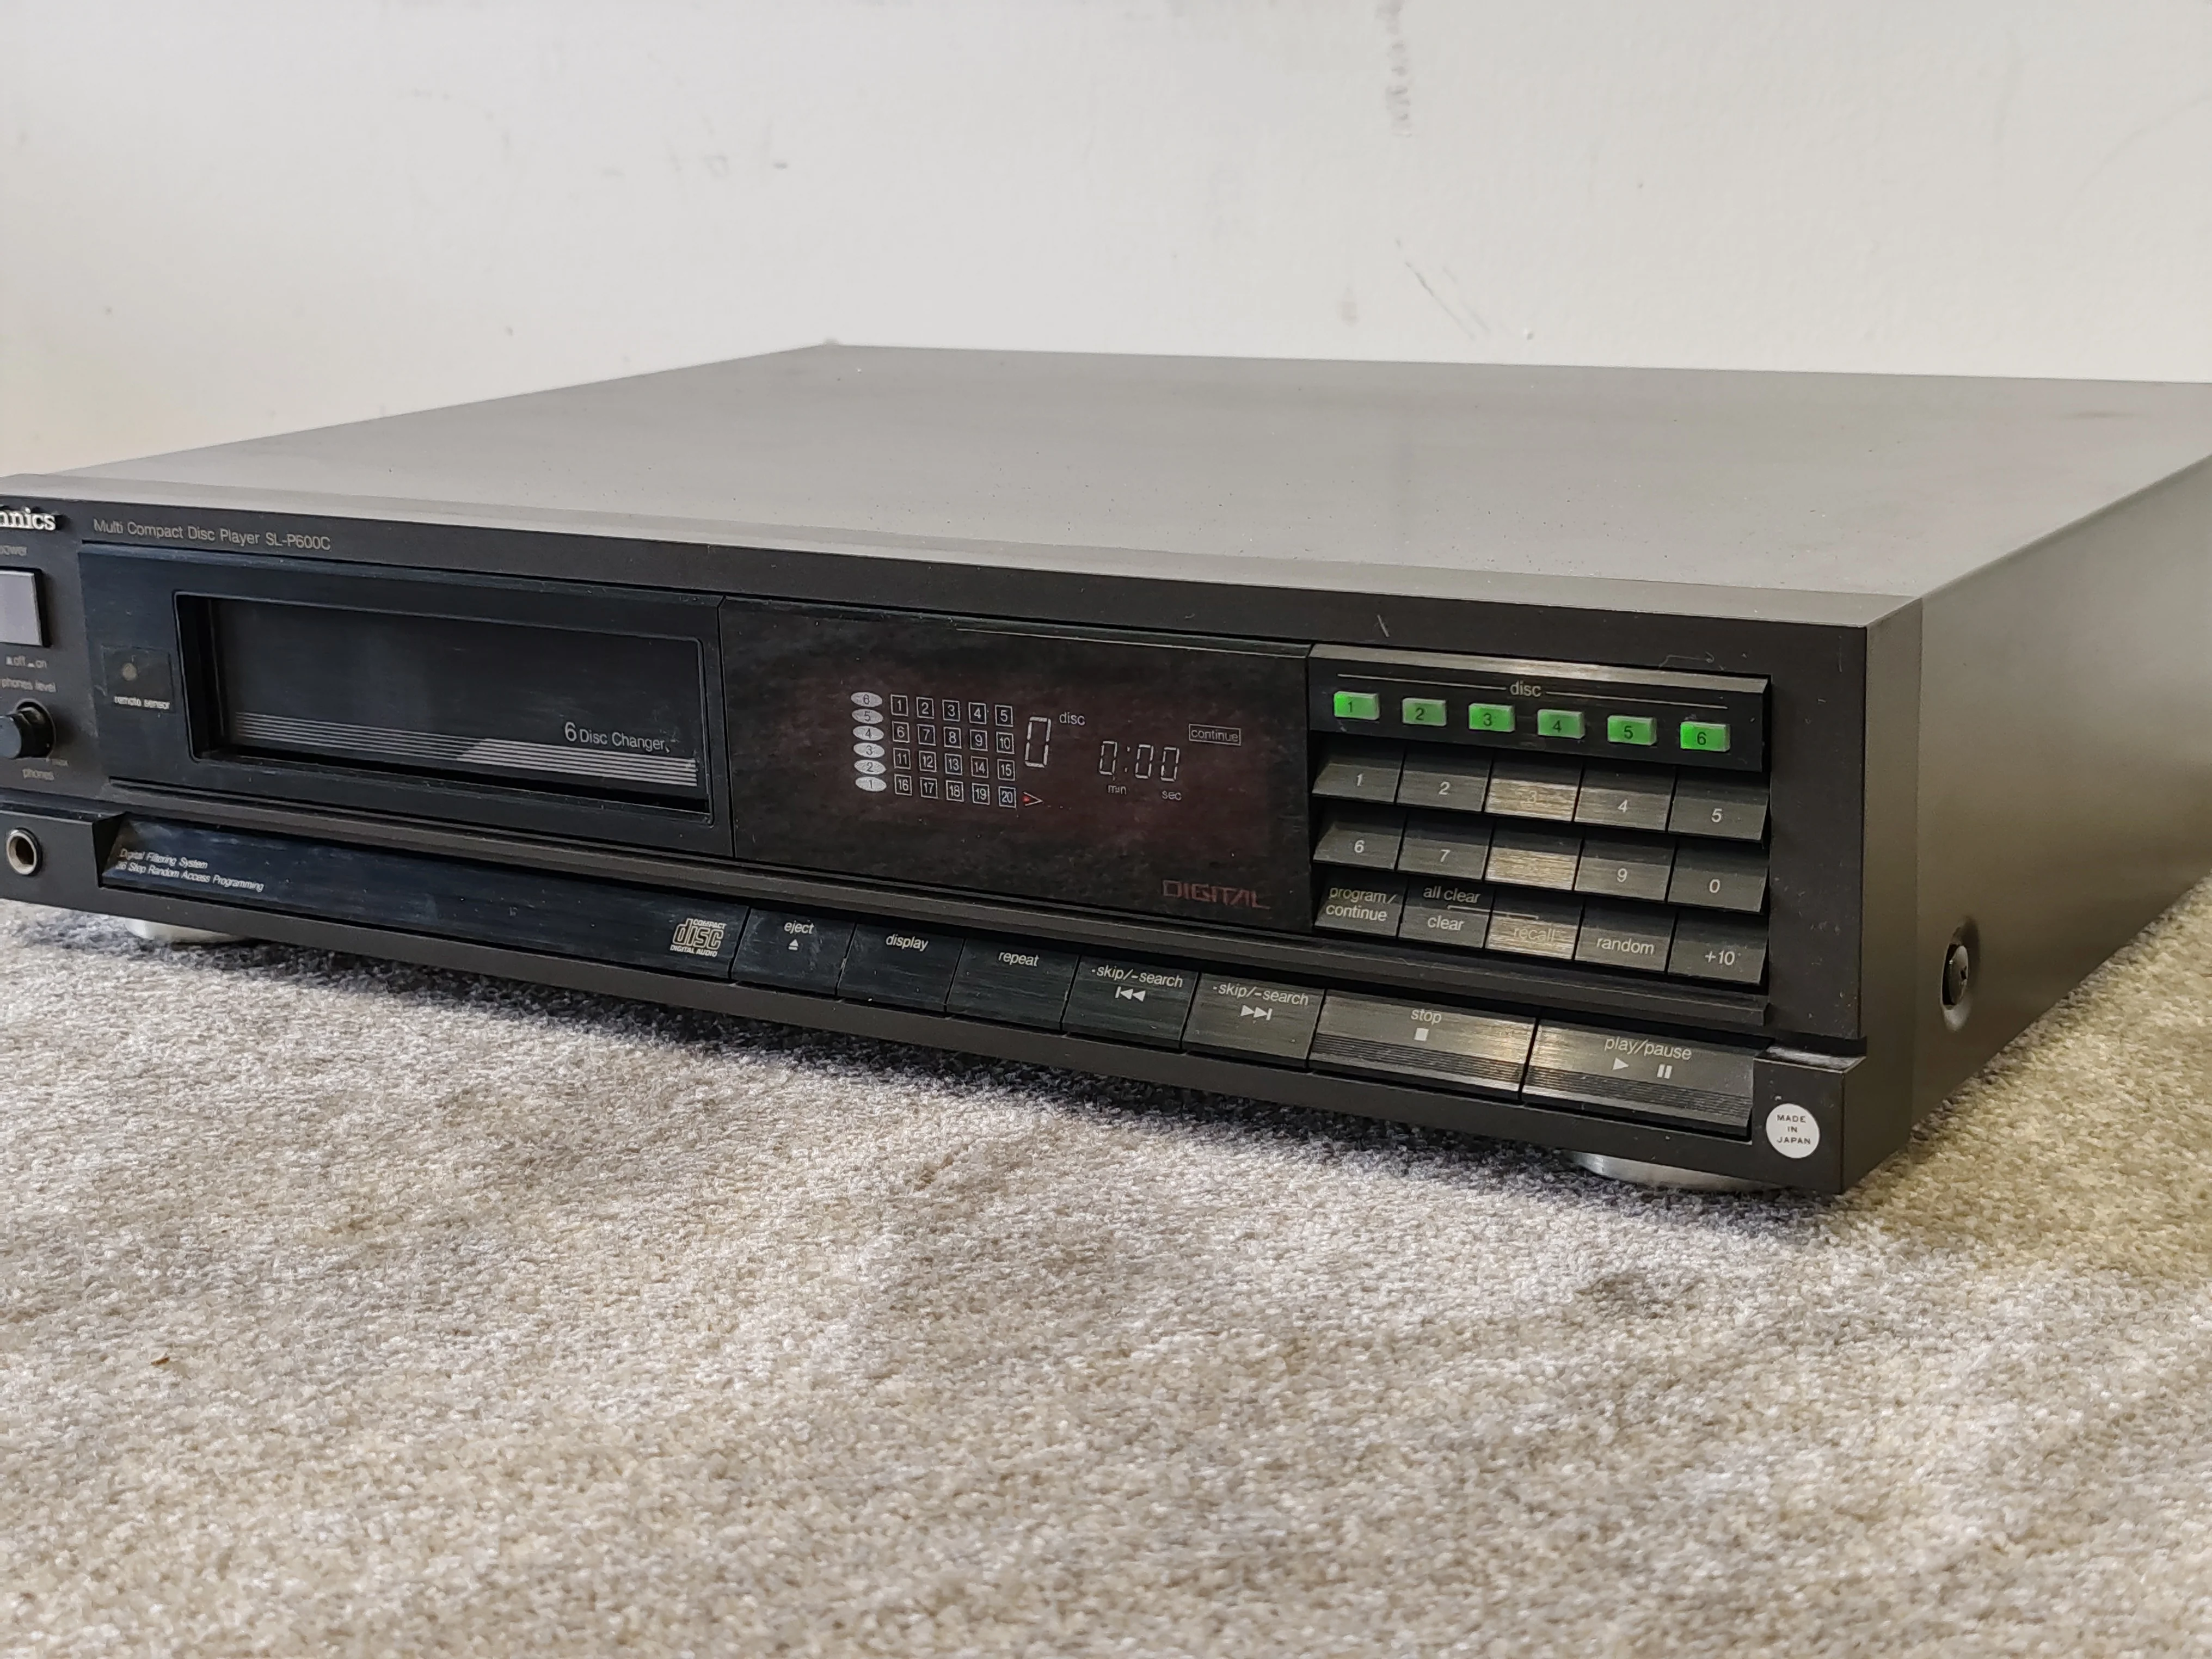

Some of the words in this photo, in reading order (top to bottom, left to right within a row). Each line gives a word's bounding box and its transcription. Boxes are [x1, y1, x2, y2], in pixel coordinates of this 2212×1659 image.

[94, 518, 124, 534] Multi
[127, 521, 183, 539] Compact
[188, 526, 216, 541] Disc
[220, 528, 260, 545] Player
[265, 533, 331, 551] SL-P600C
[1510, 681, 1541, 697] disc
[896, 700, 902, 712] 1
[922, 702, 929, 715] 2
[948, 705, 954, 717] 3
[1348, 702, 1353, 714] 1
[864, 711, 871, 722] 5
[974, 708, 981, 718] 4
[1000, 710, 1007, 722] 5
[1059, 711, 1086, 726] disc
[1416, 708, 1424, 721] 2
[1483, 713, 1492, 727] 3
[1552, 720, 1562, 733] 4
[564, 721, 577, 742] 6
[579, 729, 609, 745] Disc
[611, 732, 665, 752] Changer
[865, 728, 872, 739] 4
[897, 727, 904, 738] 6
[923, 729, 930, 741] 7
[949, 732, 956, 744] 8
[1191, 729, 1239, 742] continue
[1624, 726, 1633, 740] 5
[1697, 732, 1707, 746] 6
[975, 734, 982, 747] 9
[1000, 736, 1011, 749] 10
[897, 752, 907, 764] 11
[922, 755, 933, 768] 12
[948, 758, 959, 771] 13
[867, 762, 874, 772] 2
[974, 760, 985, 773] 14
[1000, 764, 1012, 776] 15
[898, 779, 909, 791] 16
[1356, 773, 1362, 786] 1
[924, 782, 934, 794] 17
[949, 785, 961, 797] 18
[975, 788, 986, 801] 19
[1107, 784, 1127, 795] min
[1439, 782, 1450, 796] 2
[1002, 791, 1013, 803] 20
[1162, 790, 1182, 801] sec
[1617, 800, 1628, 813] 4
[1711, 809, 1722, 822] 5
[1354, 840, 1365, 853] 6
[1440, 849, 1450, 863] 7
[179, 857, 208, 869] System
[128, 862, 147, 874] Step
[148, 864, 180, 878] Random
[181, 871, 211, 883] Access
[212, 875, 265, 893] Programming
[1617, 868, 1627, 882] 9
[1709, 879, 1721, 893] 0
[1329, 887, 1397, 904] program/
[1423, 886, 1441, 899] all
[1443, 887, 1481, 904] clear
[1325, 905, 1387, 921] continue
[692, 918, 726, 929] COMPACT
[784, 920, 814, 934] eject
[1427, 915, 1465, 931] clear
[1513, 927, 1555, 942] recall
[886, 934, 929, 951] display
[1596, 935, 1655, 955] random
[669, 945, 695, 954] DIGITAL
[696, 948, 718, 957] AUDIO
[998, 951, 1039, 967] repeat
[1704, 950, 1735, 966] +10
[1410, 1008, 1442, 1024] stop
[1605, 1036, 1692, 1060] play/pause
[1777, 1114, 1807, 1123] MADE
[1777, 1136, 1811, 1145] JAPAN
